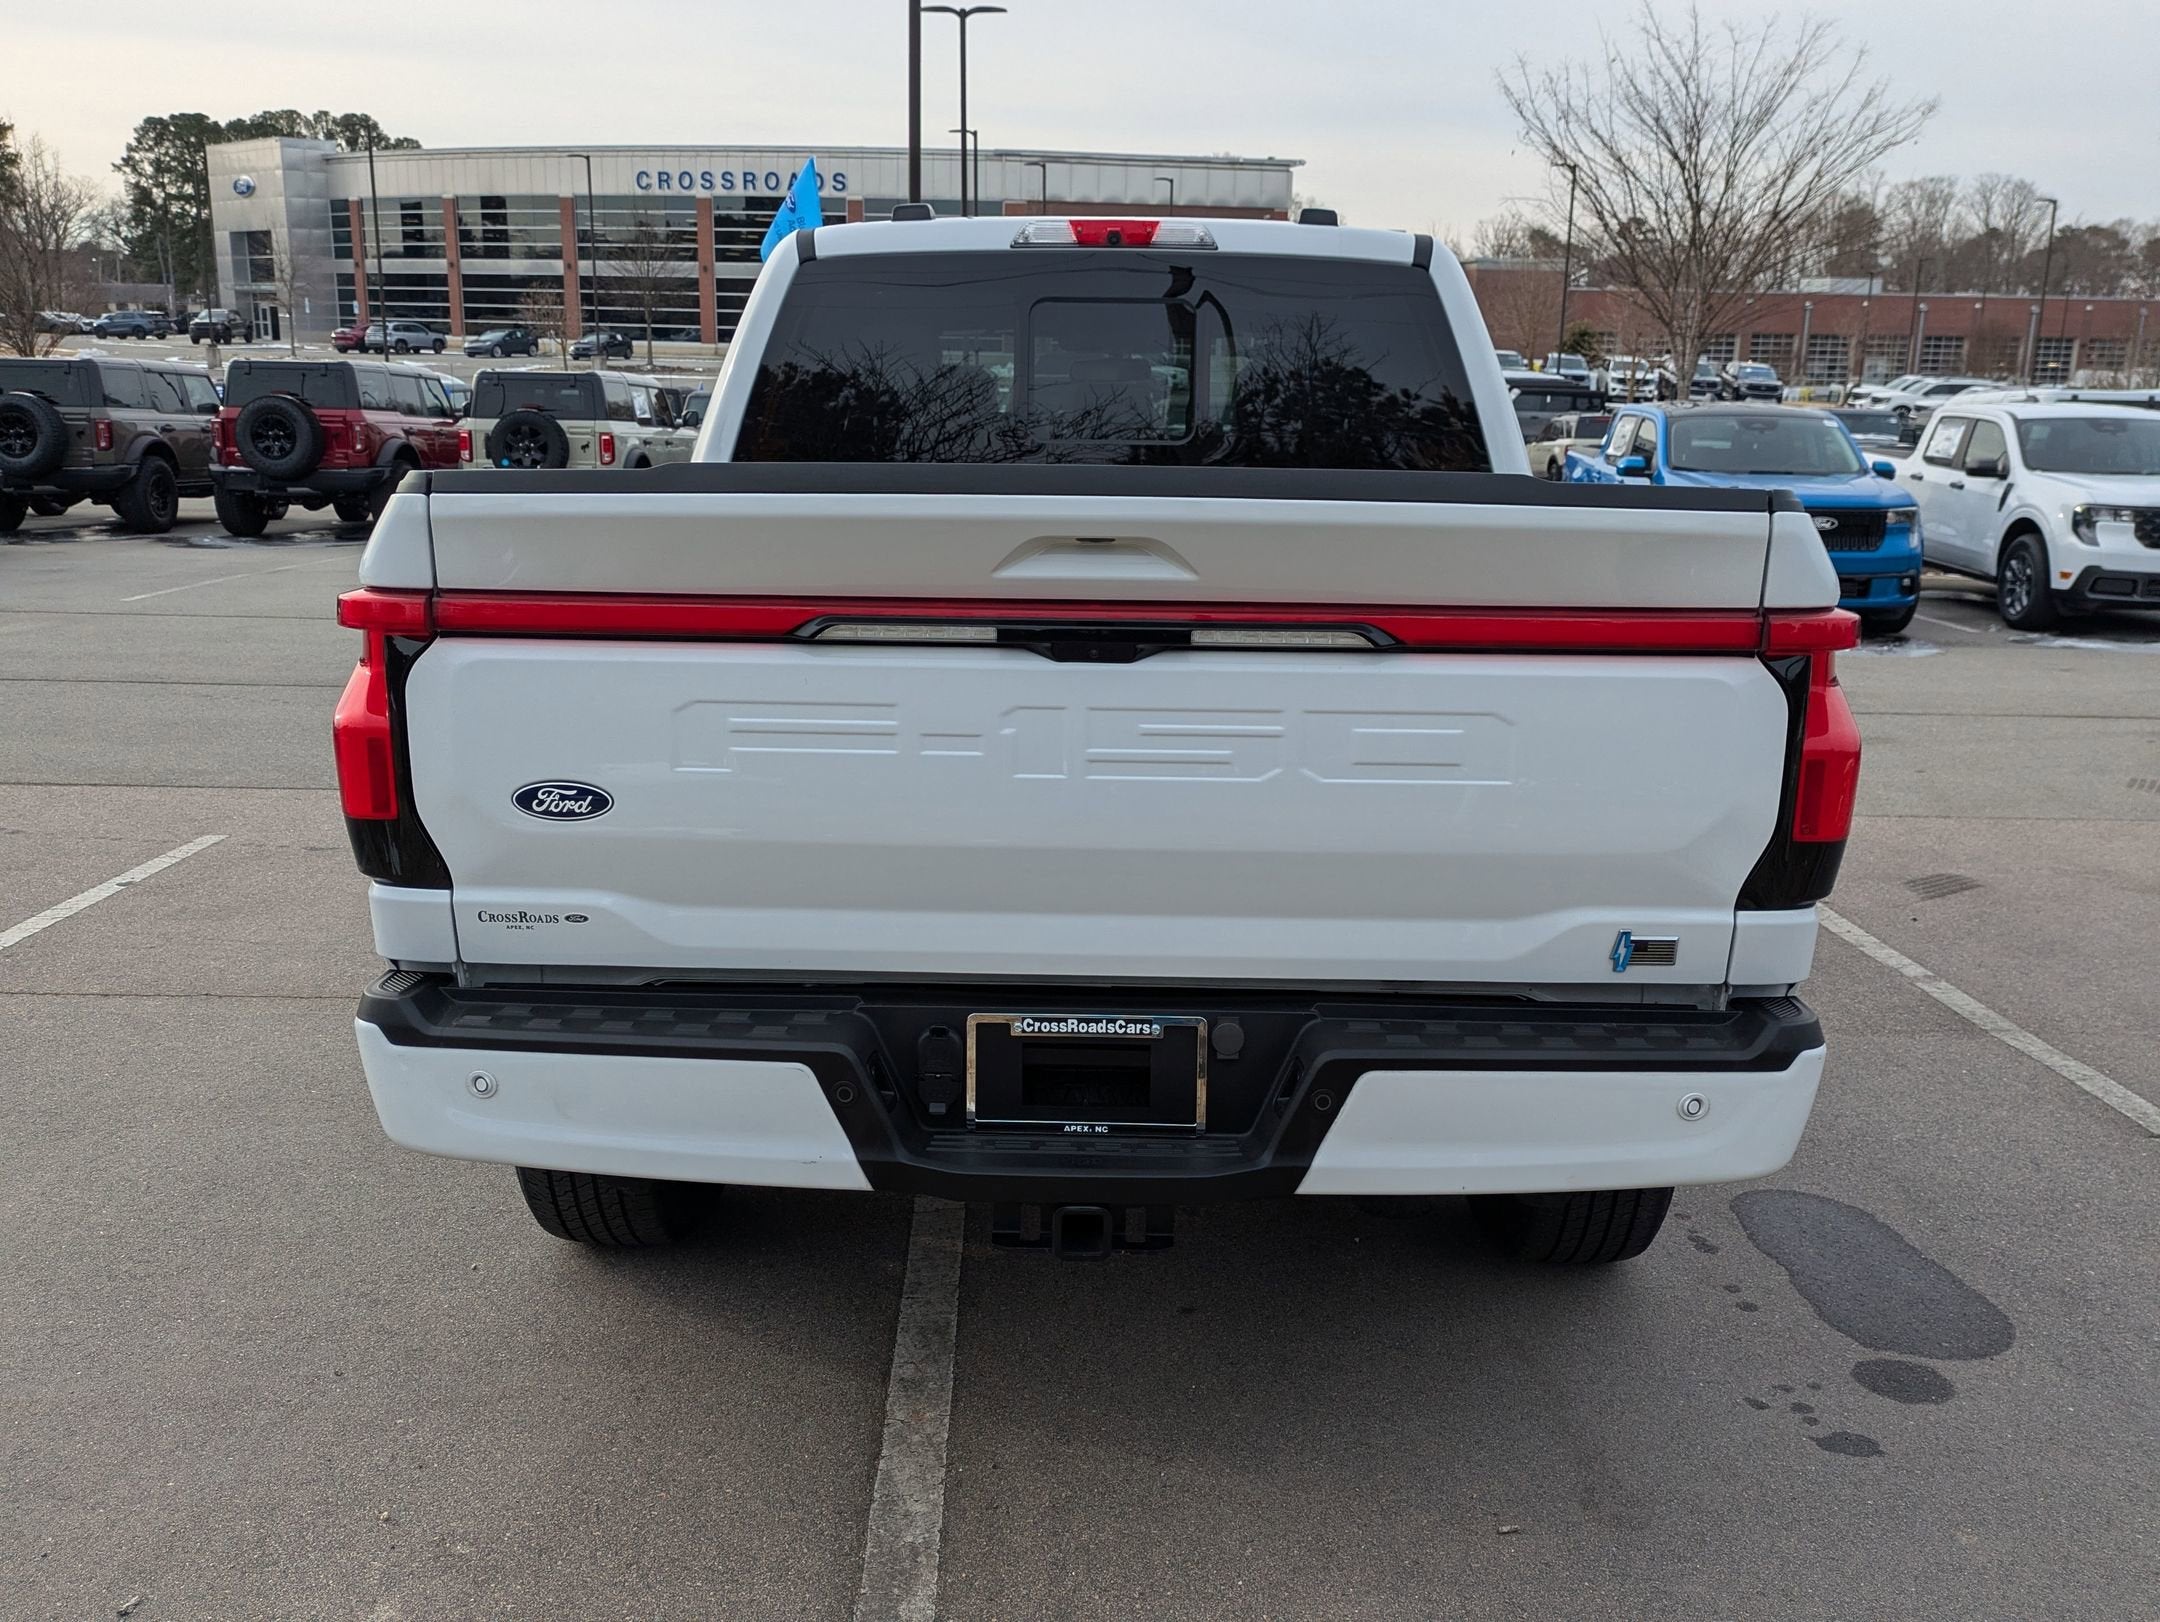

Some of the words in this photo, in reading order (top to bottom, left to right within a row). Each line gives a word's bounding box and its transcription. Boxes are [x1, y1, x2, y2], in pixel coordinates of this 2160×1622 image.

[670, 699, 1518, 787] F-150
[531, 787, 593, 814] Ford
[1022, 1018, 1150, 1035] CrossRoadsCars
